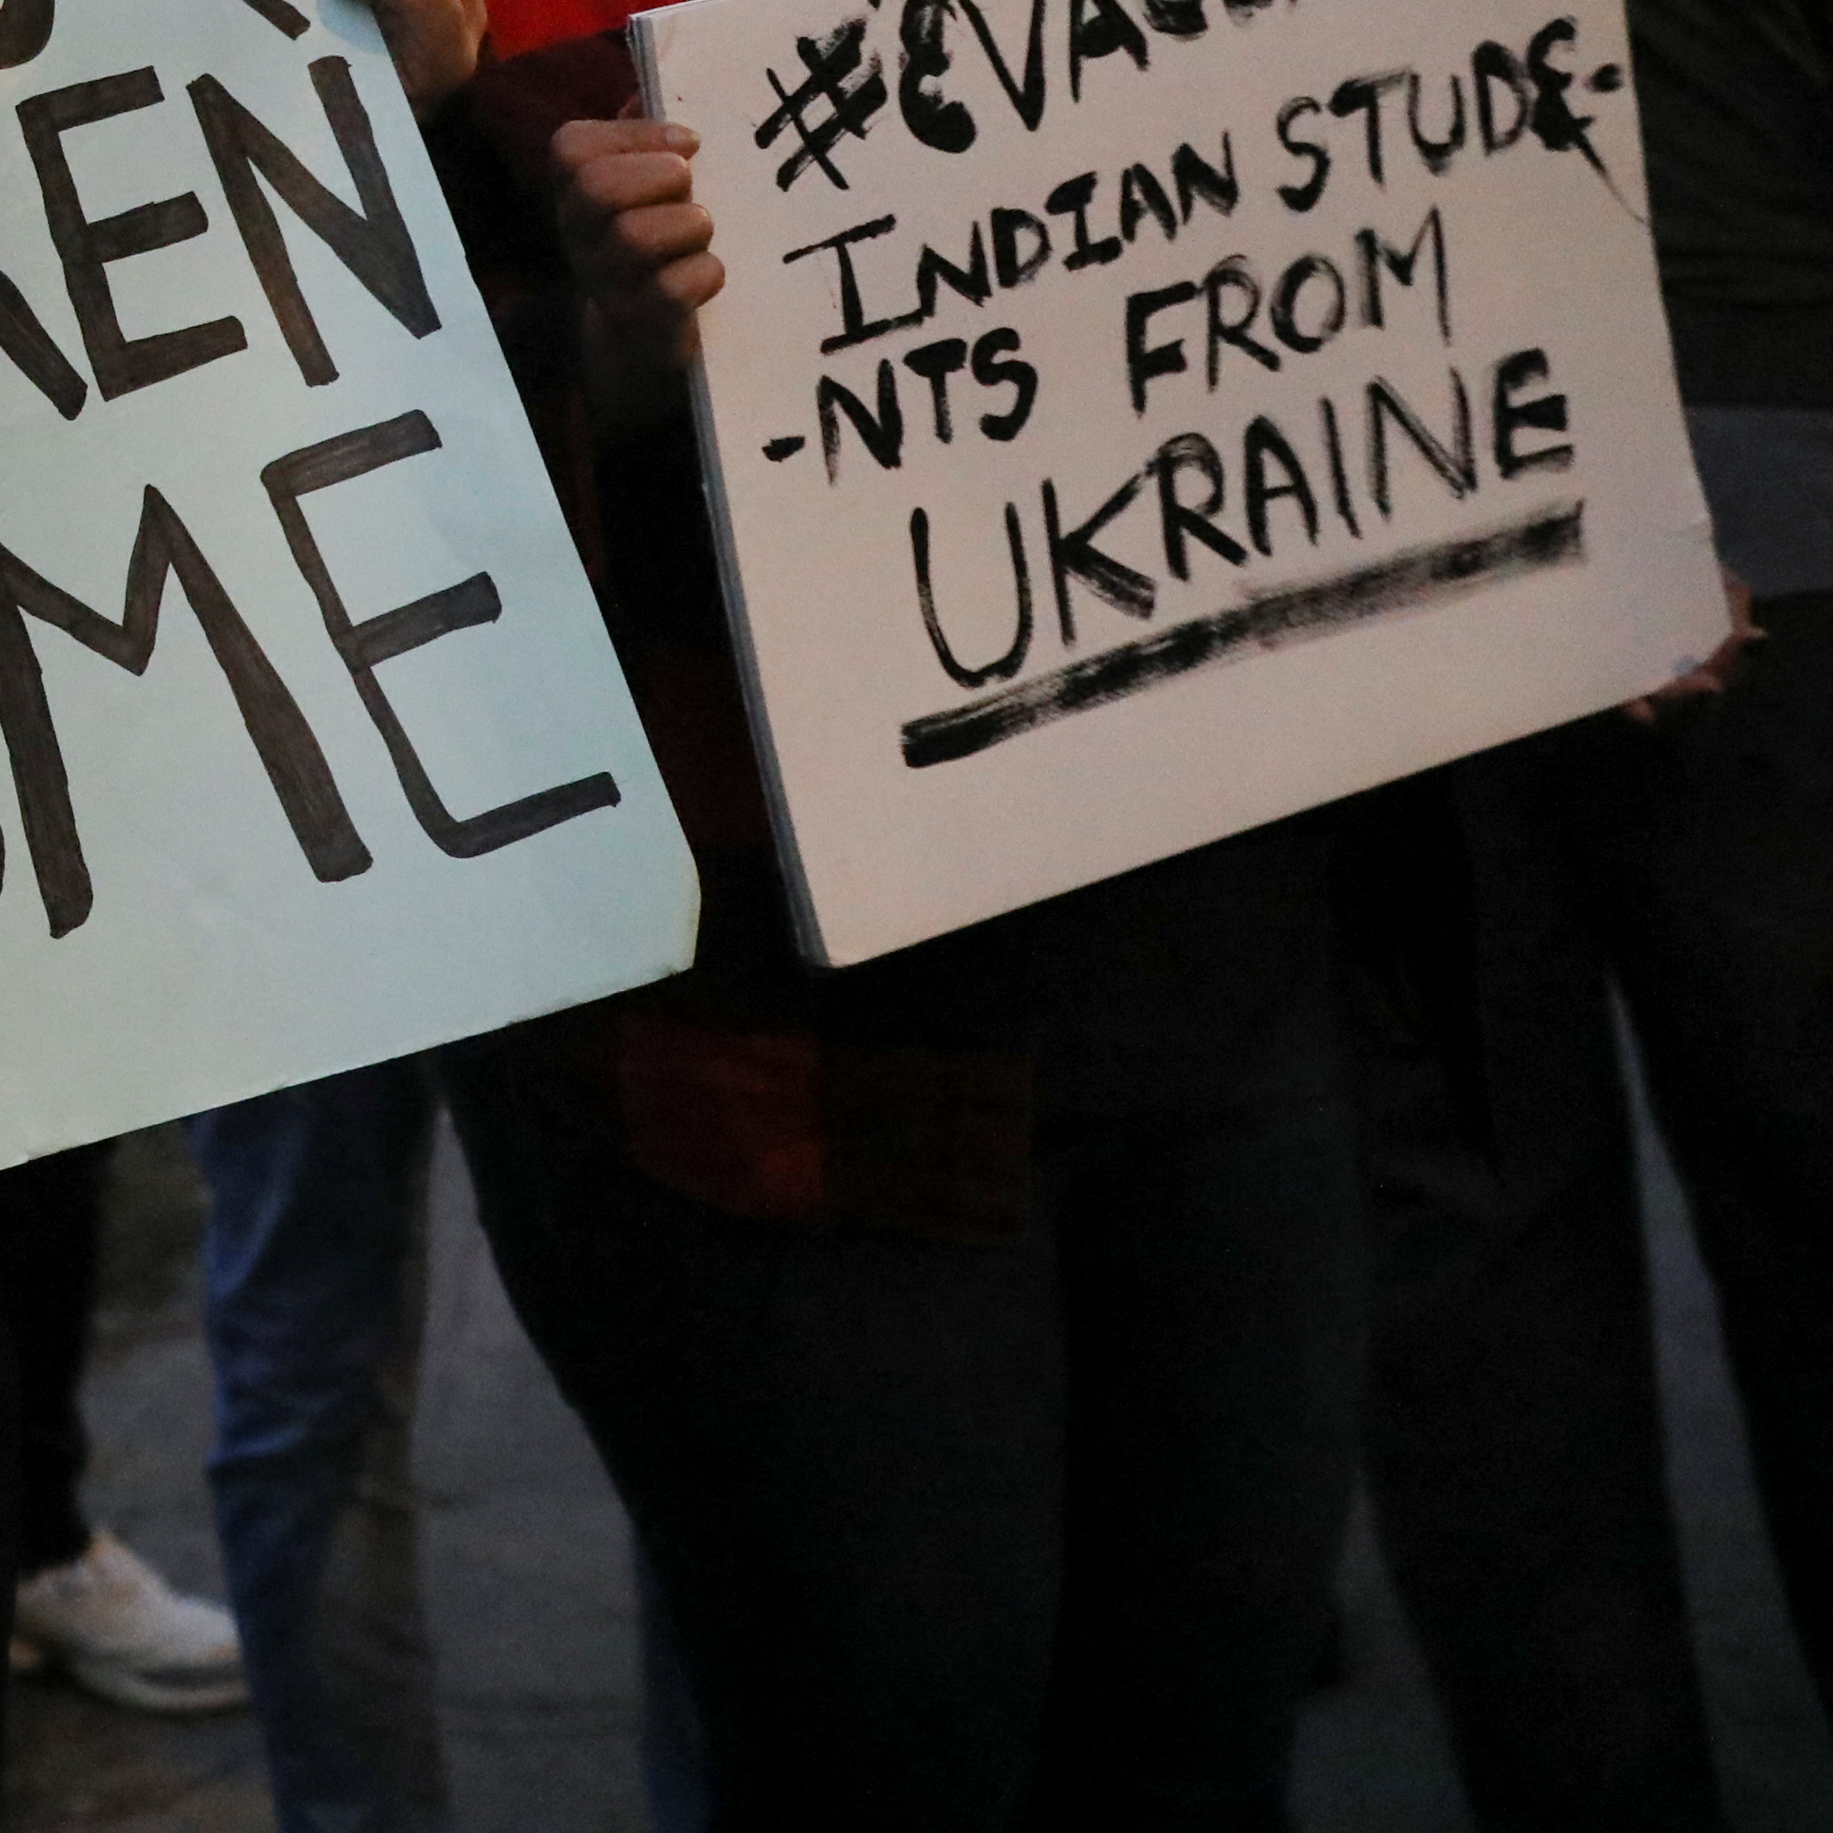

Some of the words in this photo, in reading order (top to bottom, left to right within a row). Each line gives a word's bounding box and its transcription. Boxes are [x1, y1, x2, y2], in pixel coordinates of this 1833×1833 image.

[762, 326, 1039, 485] -NTS
[1124, 207, 1452, 417] FROM
[783, 130, 1239, 356] INDIAN
[910, 348, 1575, 691] UKRAINE
